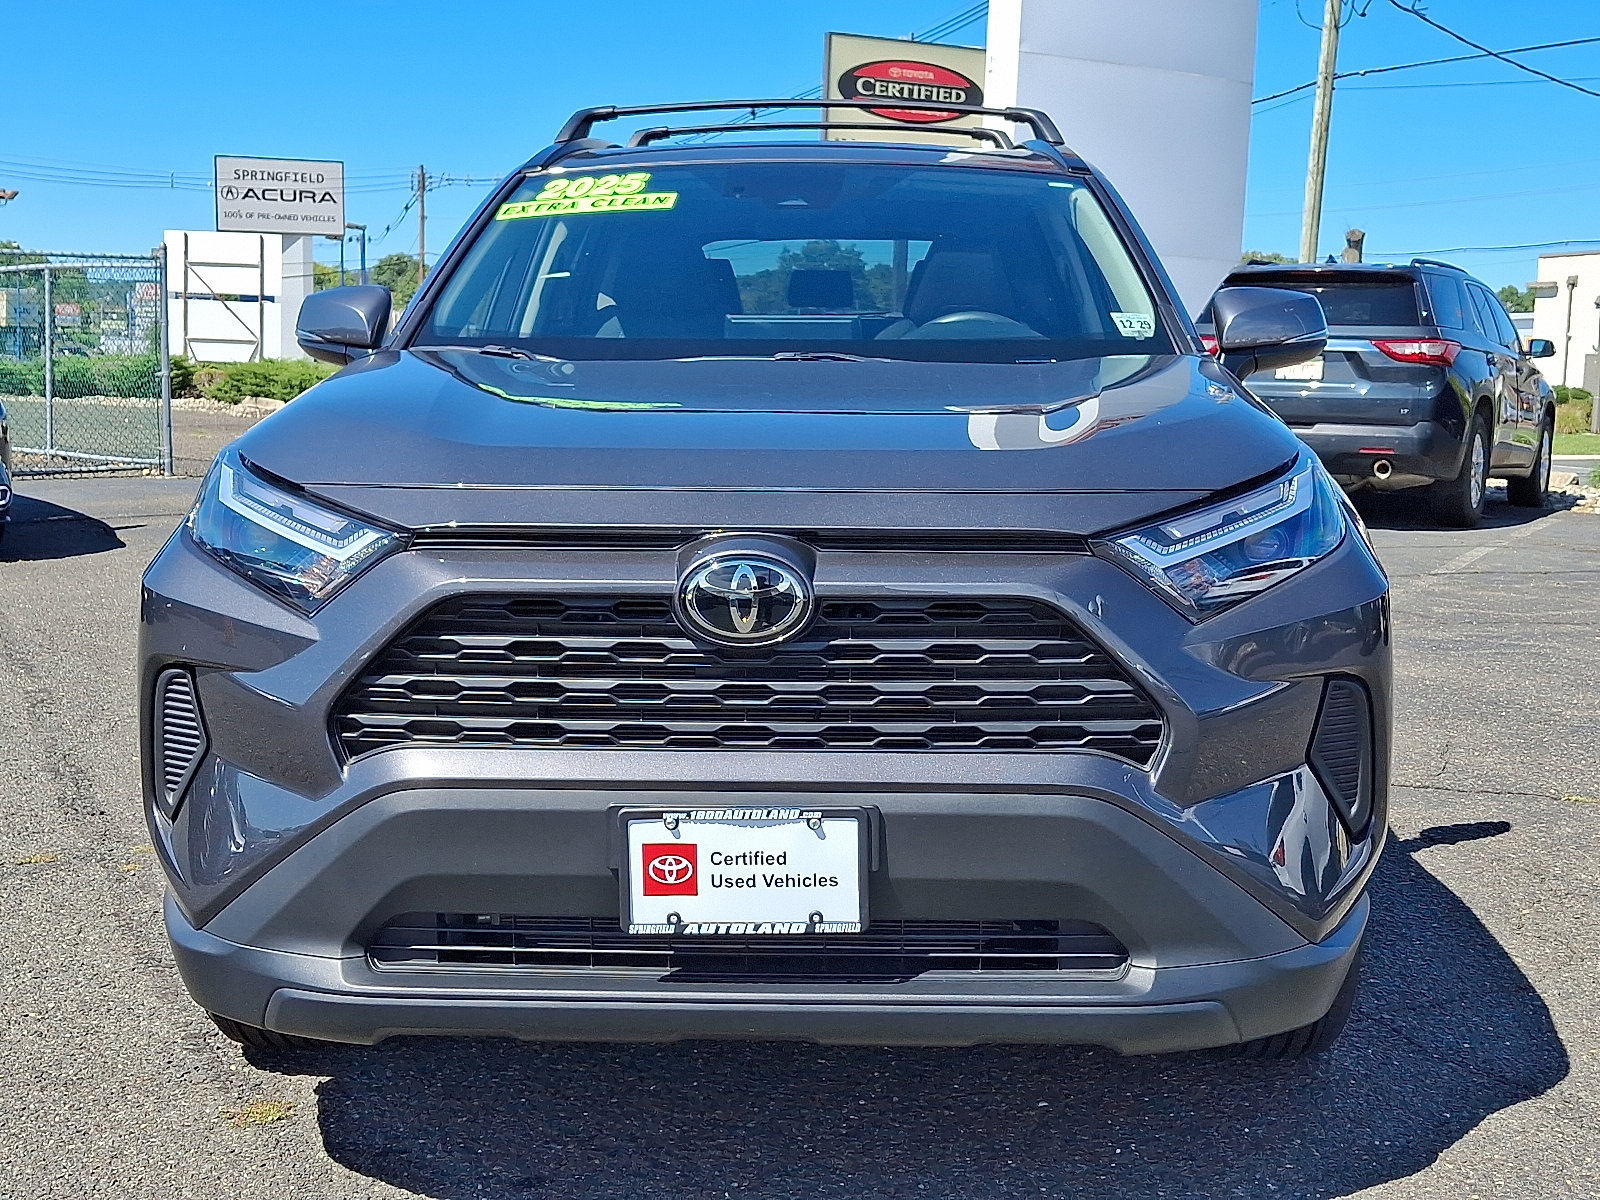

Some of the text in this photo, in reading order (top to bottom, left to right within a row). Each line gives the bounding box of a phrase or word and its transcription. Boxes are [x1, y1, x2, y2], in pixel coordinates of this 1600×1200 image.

[902, 69, 935, 80] TOYOTA
[856, 77, 967, 103] CERTIFIED
[233, 168, 325, 184] SPRINGFIELD
[536, 172, 652, 200] 2025
[241, 188, 338, 204] ACURA
[502, 195, 671, 216] EXTRA CLEAN
[245, 211, 255, 219] OF
[257, 212, 299, 221] PRE-OWNED
[300, 214, 337, 222] VEHICLES
[1119, 319, 1152, 330] 12 29
[710, 851, 787, 866] Certified
[710, 872, 839, 889] Used Vehicles
[628, 922, 862, 935] SPRINGFIELD AUTOLAND SPRINGFIELD
